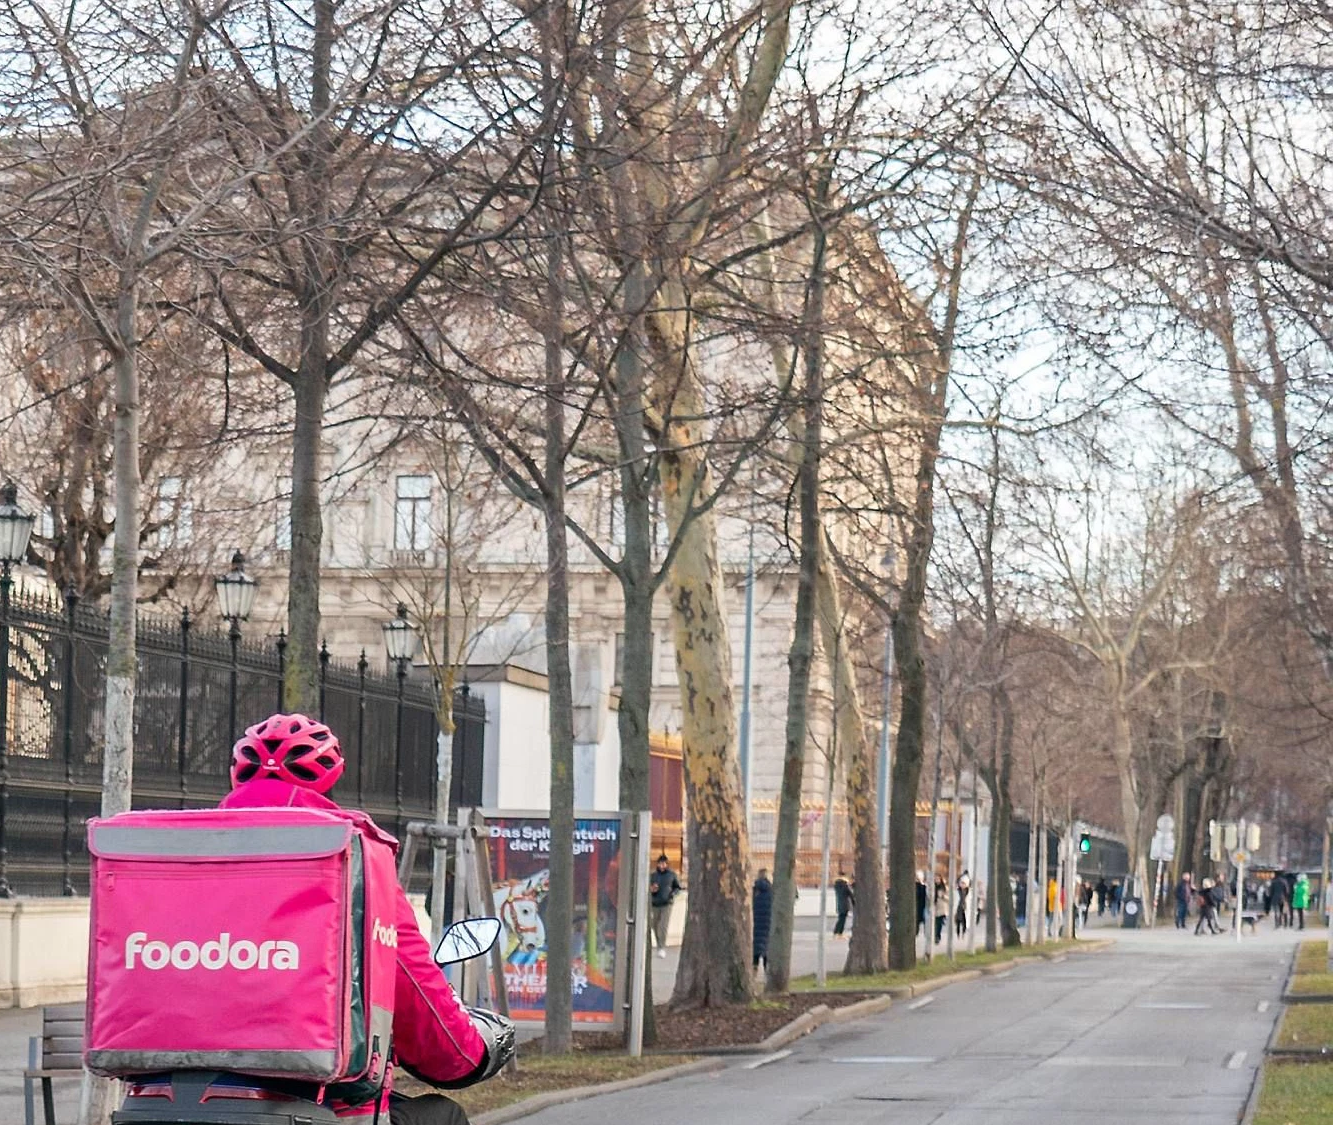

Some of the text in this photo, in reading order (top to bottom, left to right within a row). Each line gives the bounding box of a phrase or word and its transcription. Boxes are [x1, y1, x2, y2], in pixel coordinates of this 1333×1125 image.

[489, 826, 520, 838] Das
[509, 839, 538, 851] der
[125, 932, 299, 970] foodora
